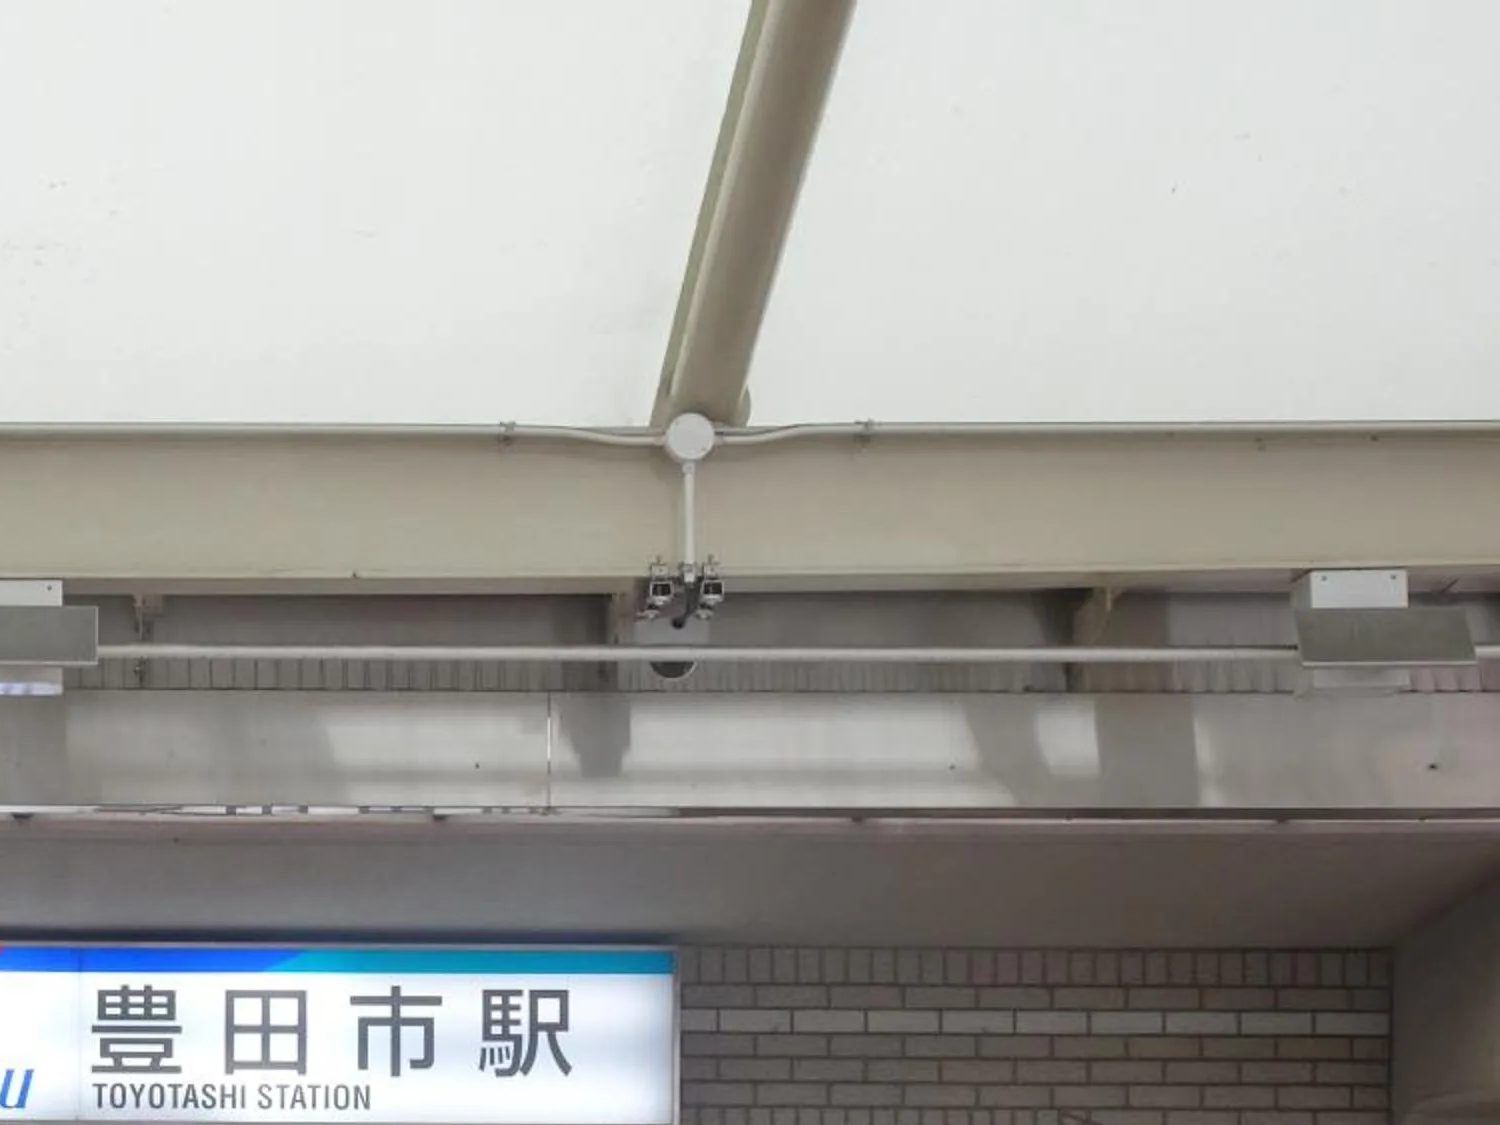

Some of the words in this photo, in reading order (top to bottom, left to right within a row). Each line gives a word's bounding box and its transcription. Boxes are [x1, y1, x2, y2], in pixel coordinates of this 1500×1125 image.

[91, 985, 572, 1077] 豊田市駅
[92, 1083, 246, 1110] TOYOTASHI
[257, 1084, 371, 1111] STATION
